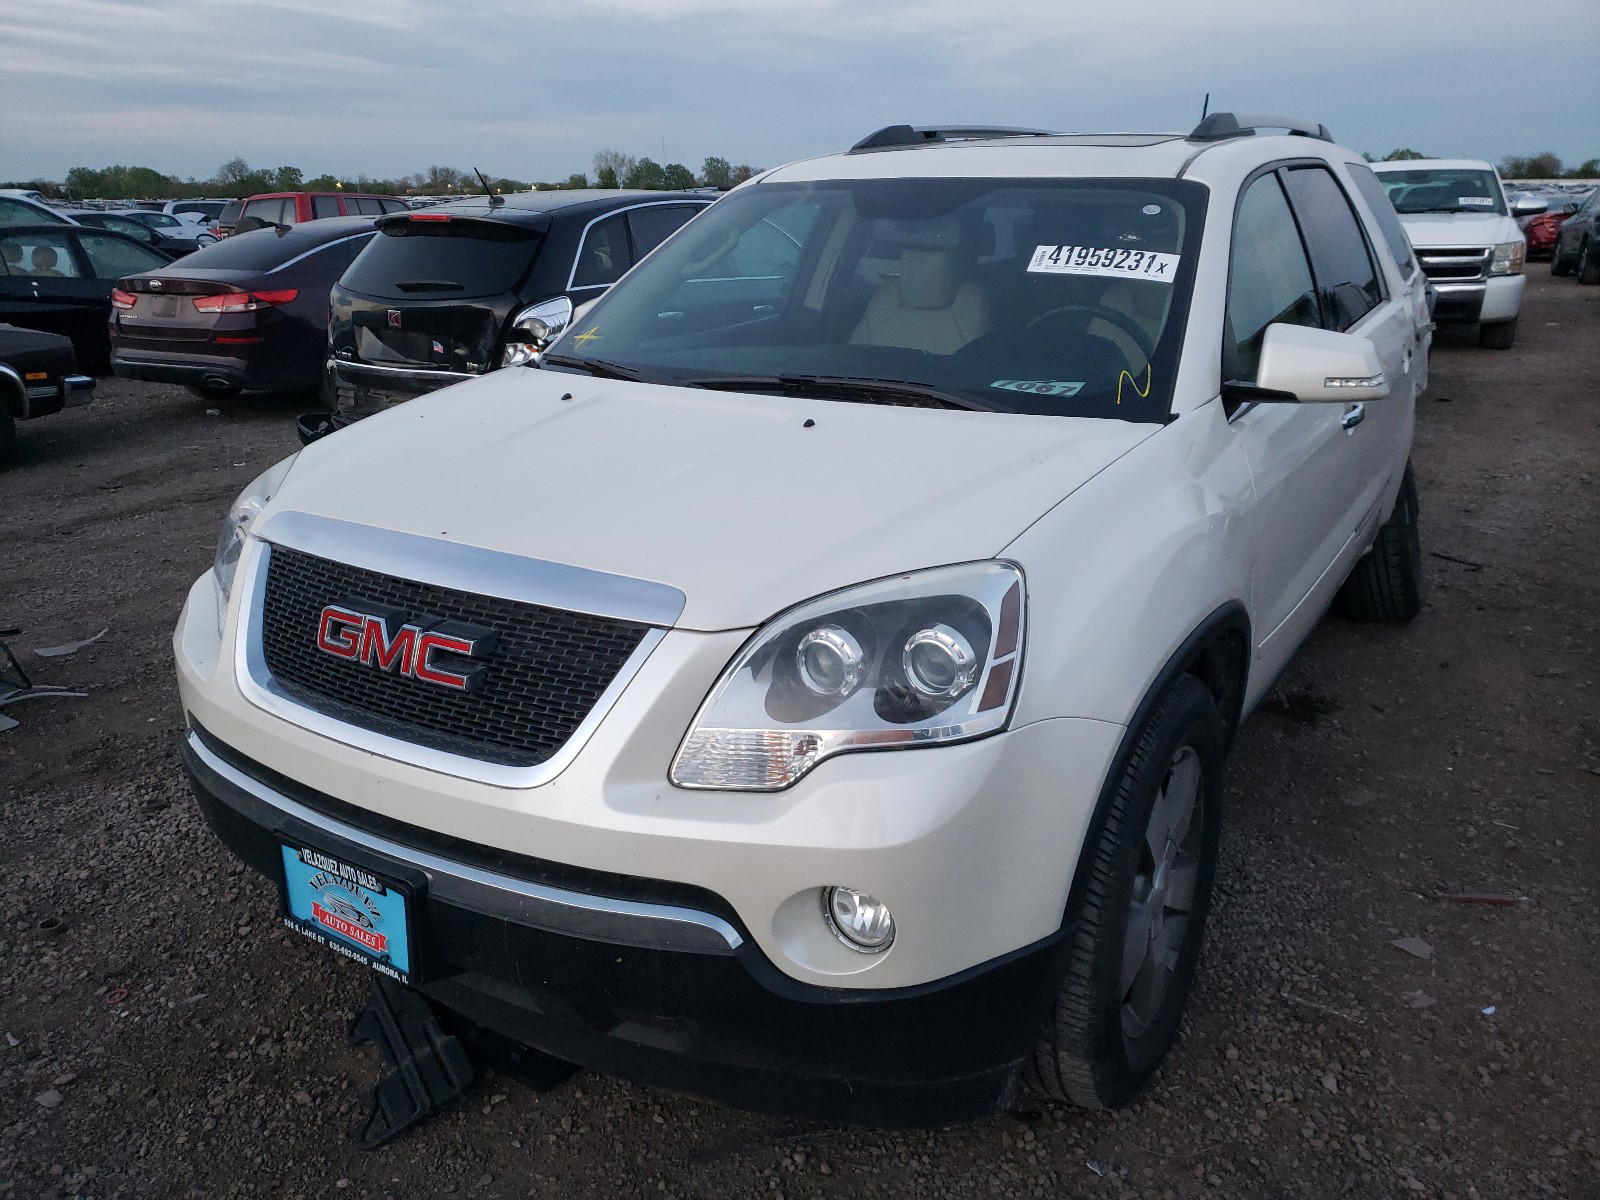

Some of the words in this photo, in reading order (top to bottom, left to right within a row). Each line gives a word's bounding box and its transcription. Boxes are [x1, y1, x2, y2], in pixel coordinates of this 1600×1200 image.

[1048, 245, 1157, 273] 41959231
[317, 604, 477, 691] GMC
[301, 847, 340, 876] VELAZQUEZ
[339, 862, 357, 884] AUTO
[356, 870, 377, 890] SALES
[323, 914, 348, 932] AUTO
[348, 926, 376, 947] SALES
[301, 927, 317, 941] LAKE
[372, 961, 401, 982] AURORA,
[401, 974, 409, 985] IL
